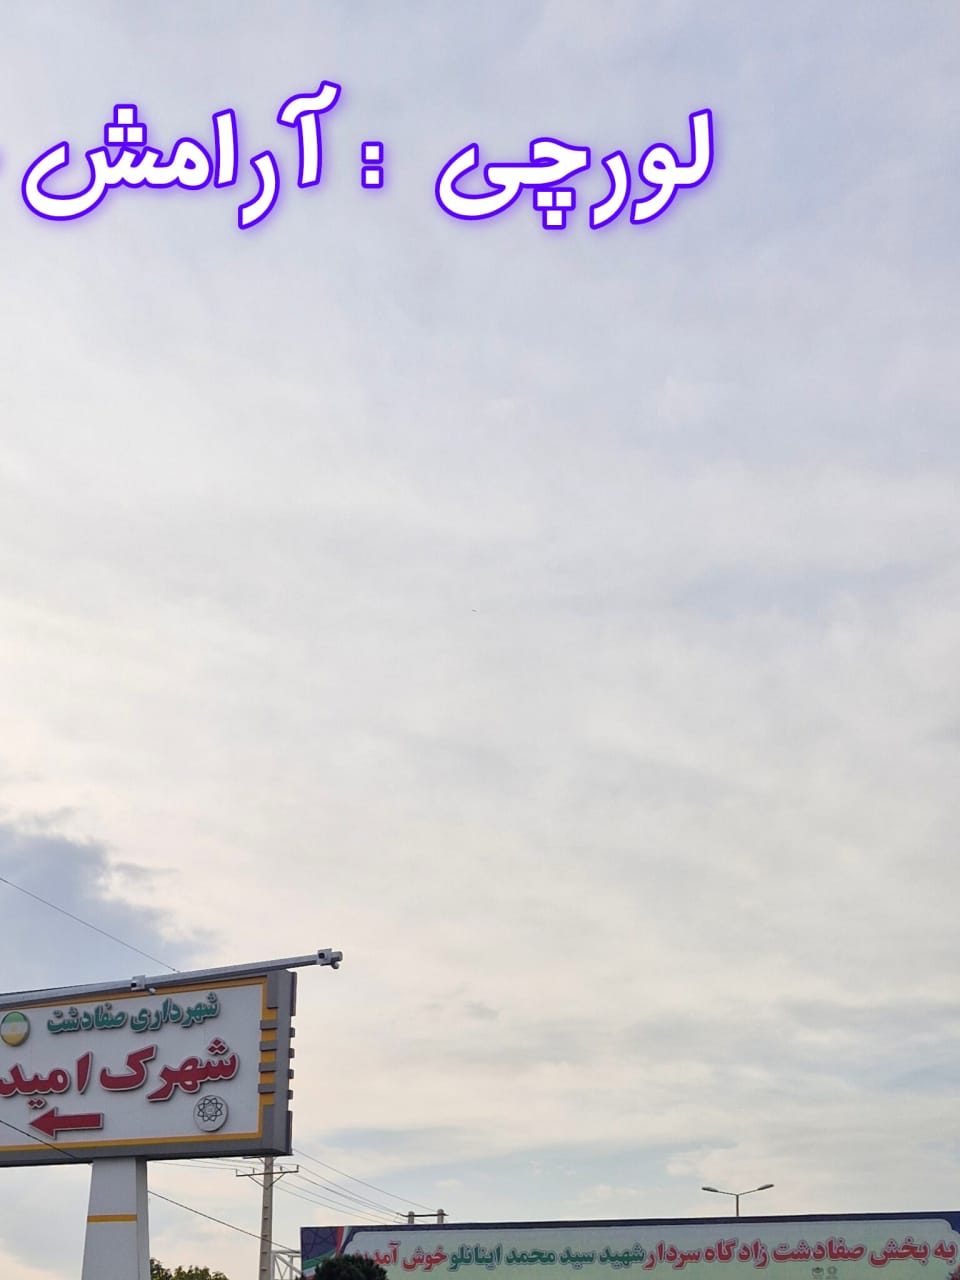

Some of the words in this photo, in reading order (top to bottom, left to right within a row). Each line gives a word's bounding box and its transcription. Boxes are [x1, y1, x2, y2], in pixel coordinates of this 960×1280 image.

[47, 1002, 127, 1034] صفادشت
[130, 992, 220, 1032] شهرداری
[99, 1037, 238, 1102] شهرک
[402, 1245, 447, 1272] خوش
[506, 1247, 556, 1266] محمد
[559, 1249, 594, 1269] سید
[599, 1243, 645, 1268] شهید
[643, 1241, 700, 1269] سردار
[773, 1237, 865, 1261] صفادشت
[869, 1236, 928, 1266] بخش
[933, 1238, 958, 1265] به
